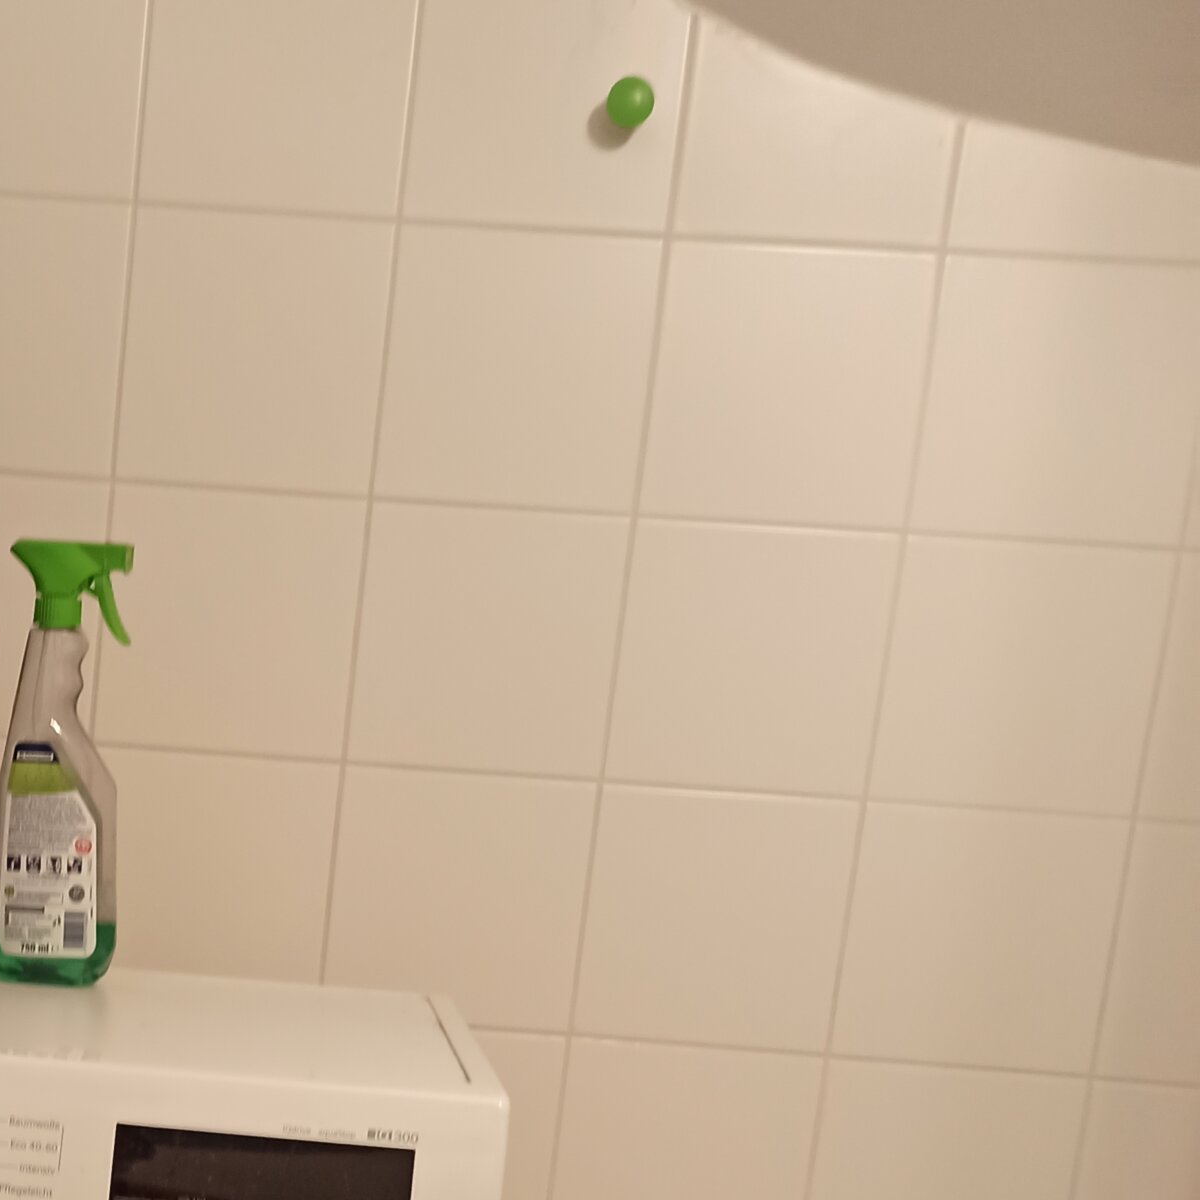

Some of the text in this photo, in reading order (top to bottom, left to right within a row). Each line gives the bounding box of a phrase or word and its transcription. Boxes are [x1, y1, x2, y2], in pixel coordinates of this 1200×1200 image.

[9, 1115, 60, 1130] Baumwolle
[10, 1139, 26, 1150] Eco
[0, 1183, 52, 1198] Pflegeleicht
